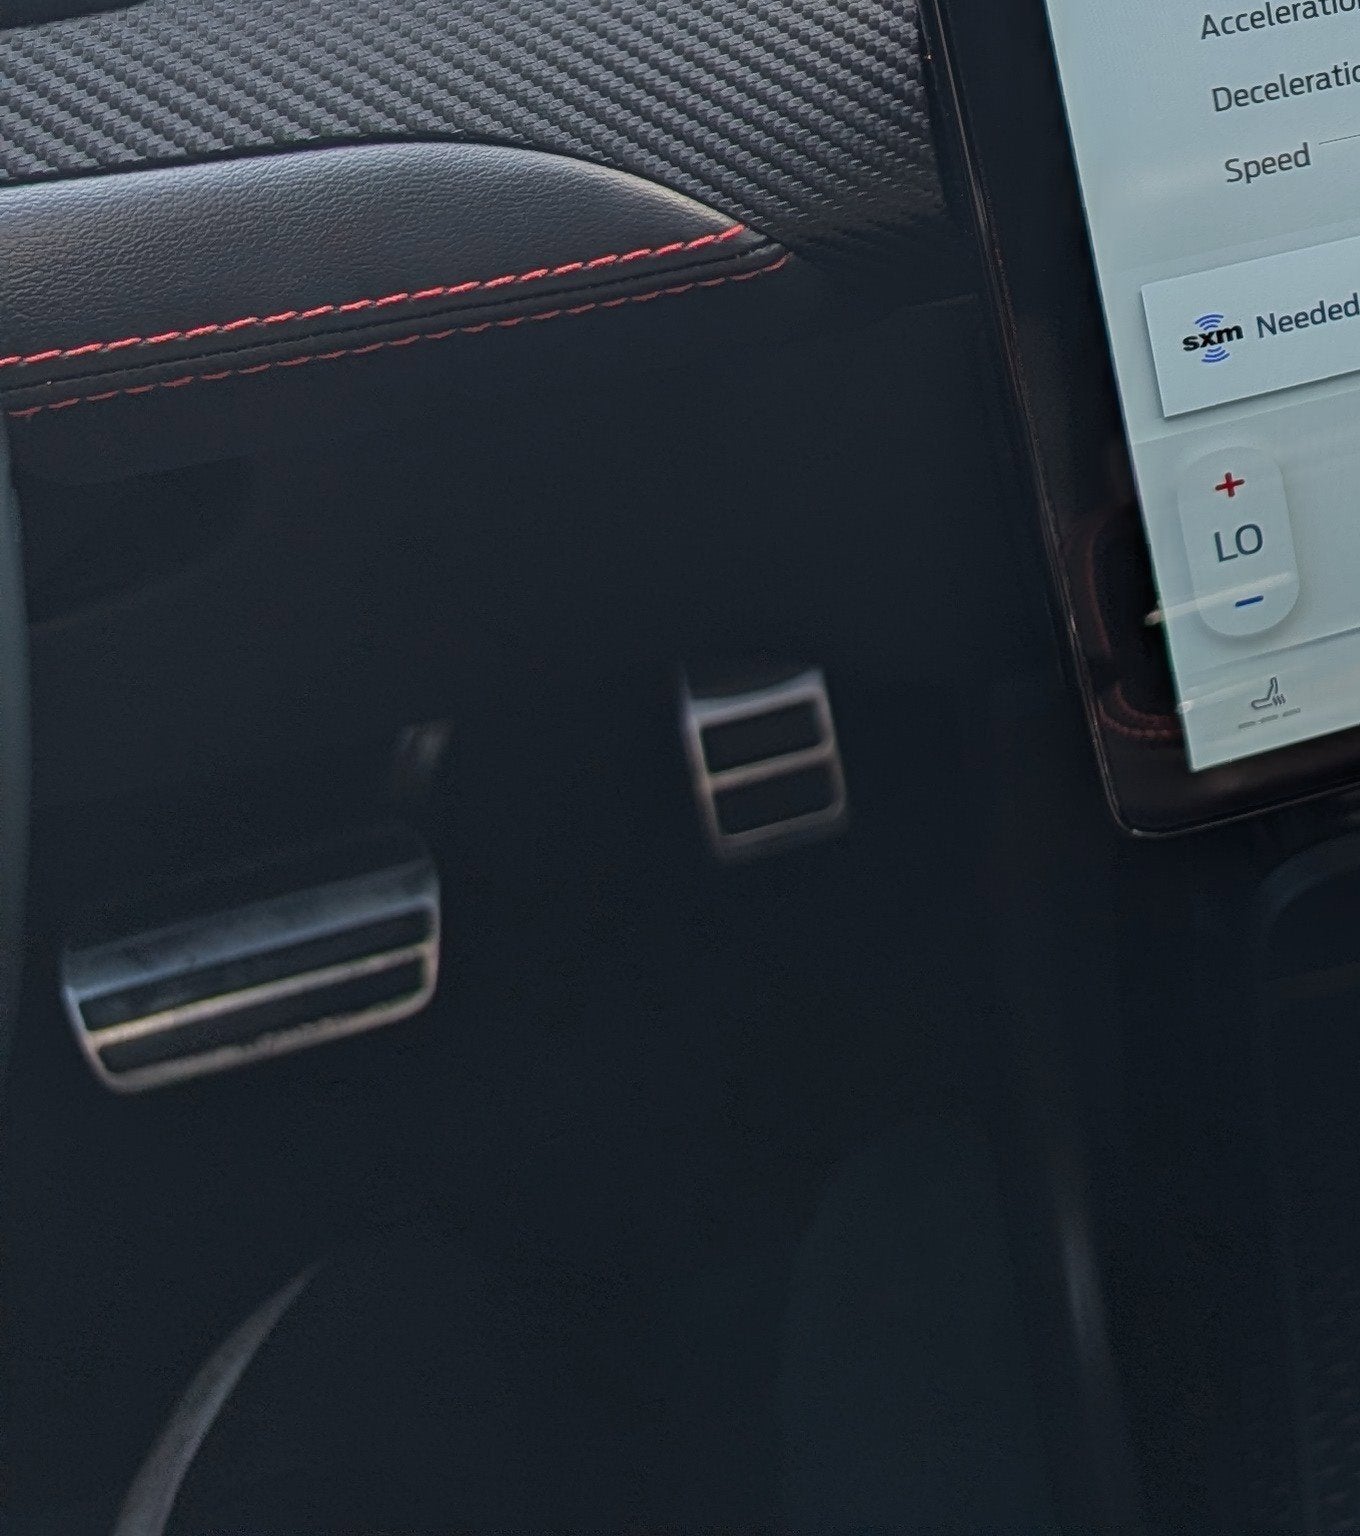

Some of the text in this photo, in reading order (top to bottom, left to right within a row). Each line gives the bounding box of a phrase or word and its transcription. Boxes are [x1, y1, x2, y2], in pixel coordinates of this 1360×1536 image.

[1225, 143, 1310, 184] Speed
[1256, 293, 1360, 338] Needed
[1183, 326, 1242, 351] sxm
[1214, 524, 1263, 562] LO
